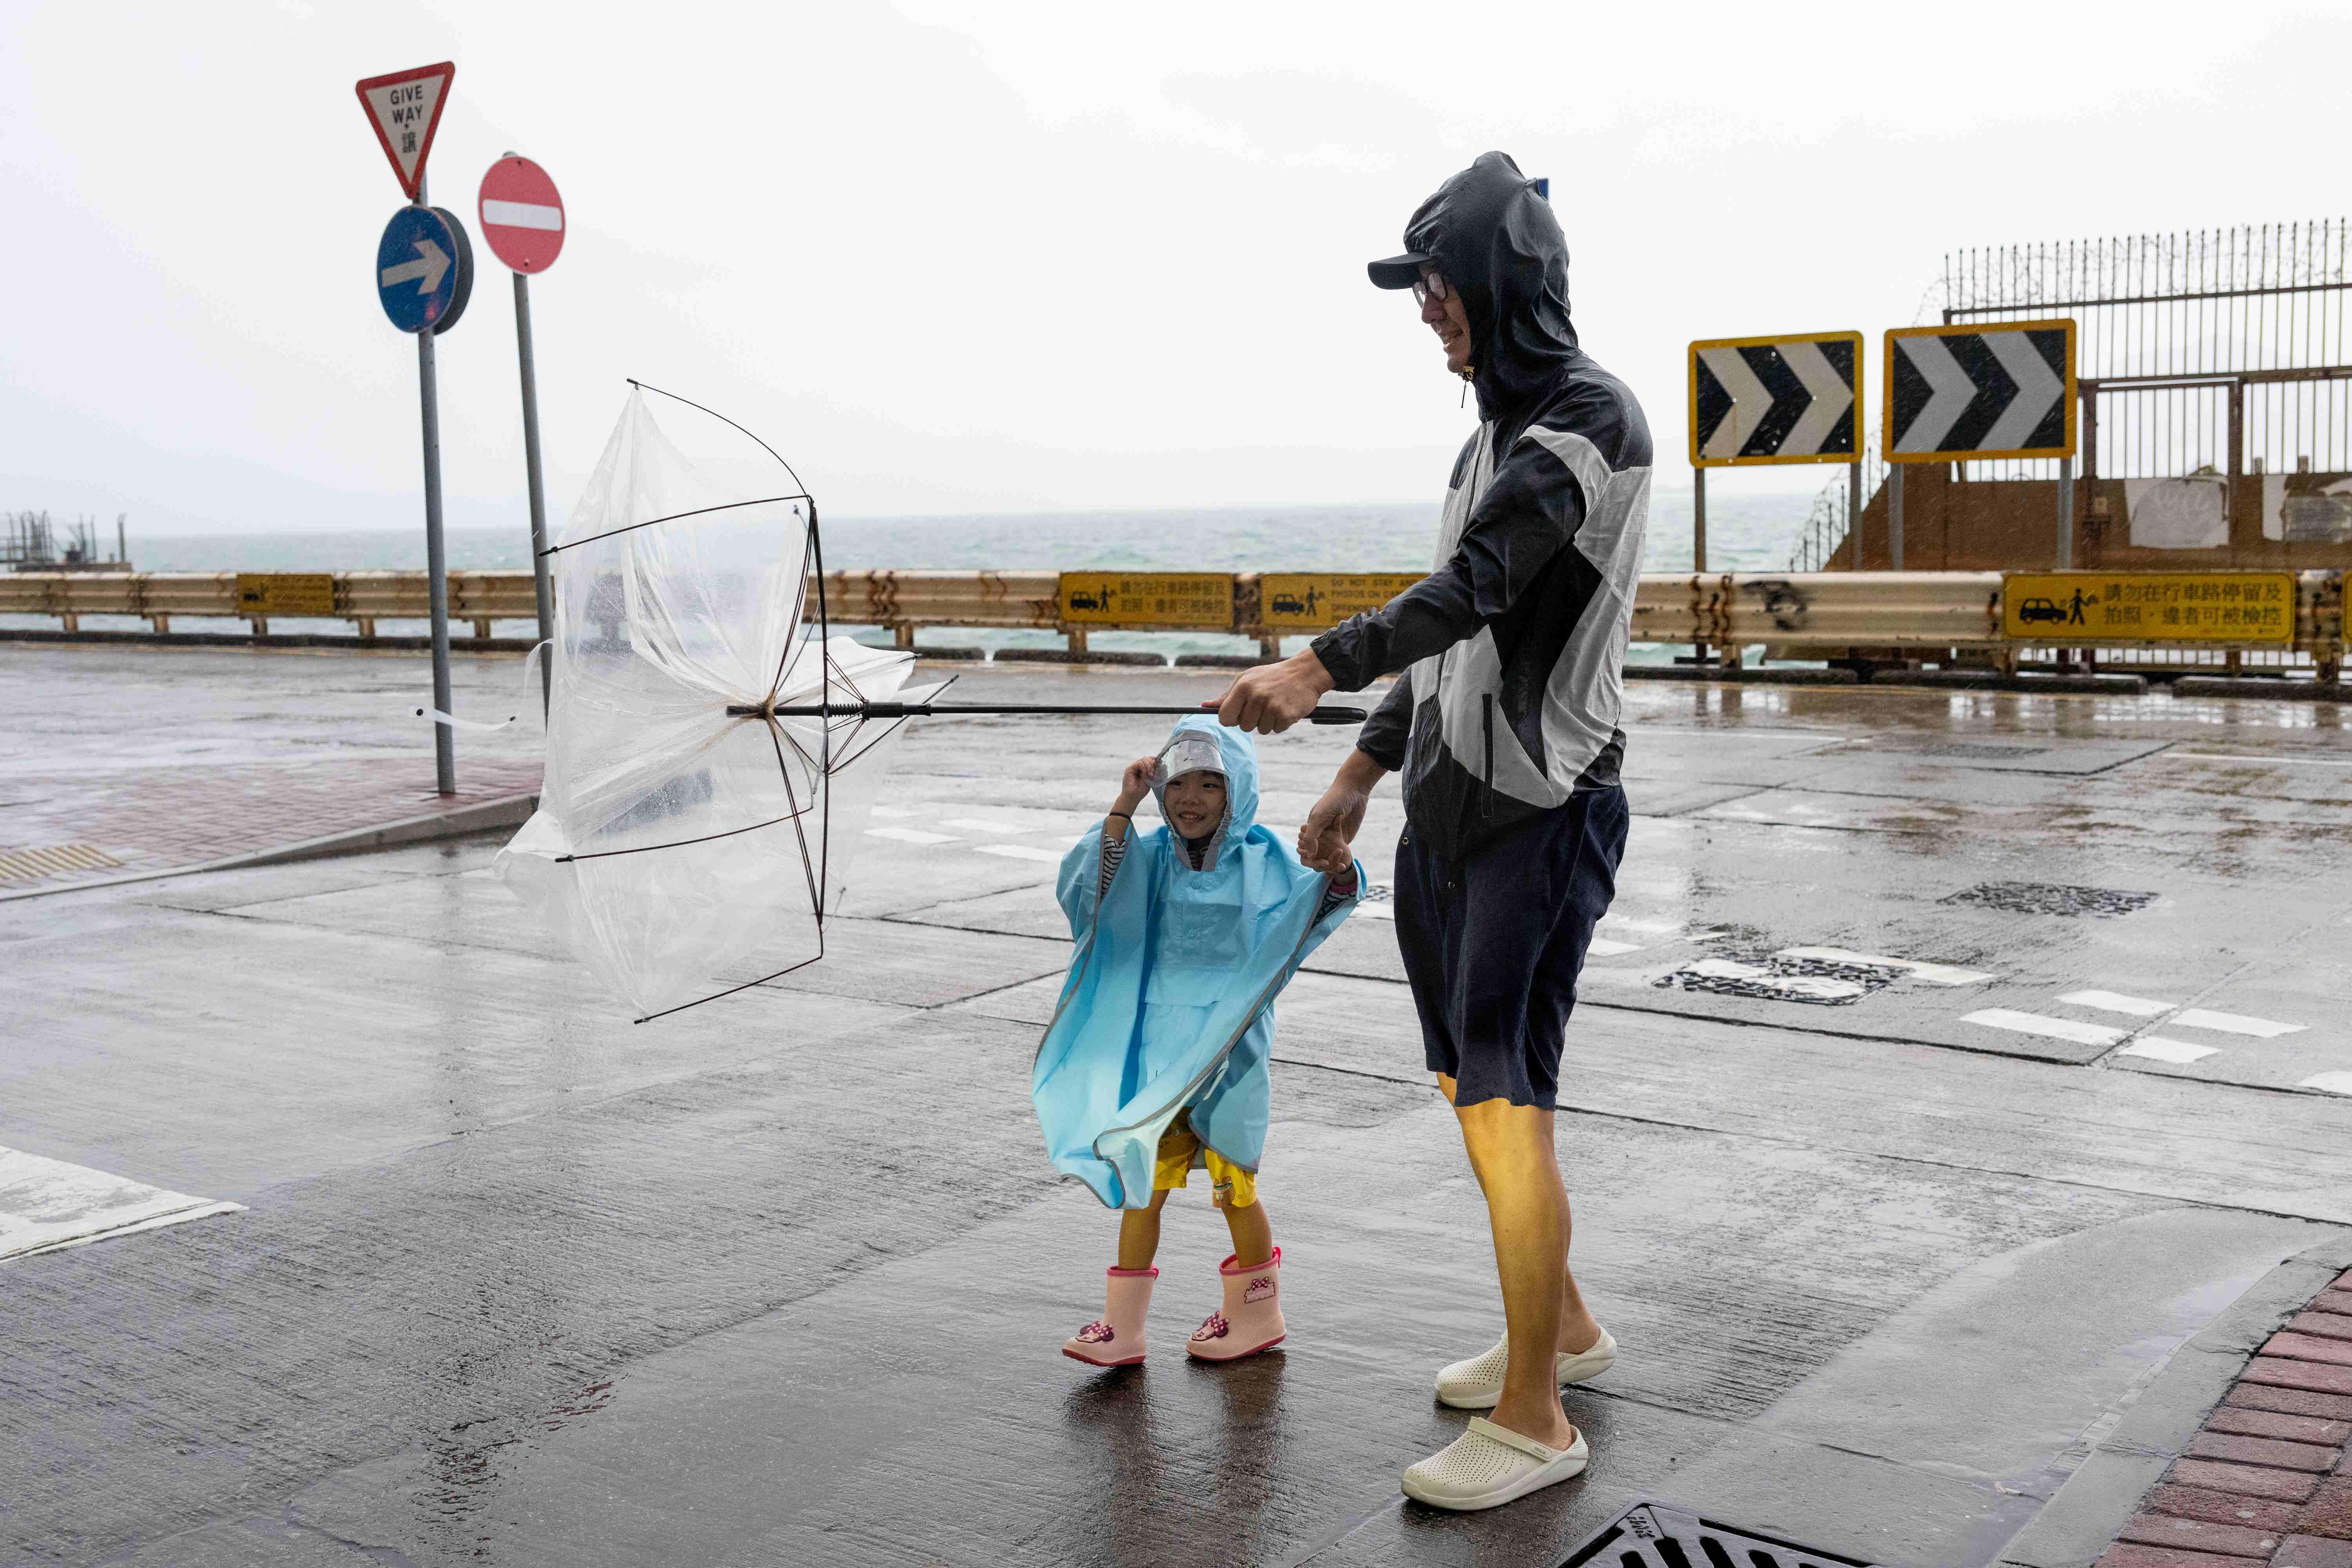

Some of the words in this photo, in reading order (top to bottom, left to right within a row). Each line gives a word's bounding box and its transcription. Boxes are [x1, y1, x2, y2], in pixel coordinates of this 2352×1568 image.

[390, 85, 423, 104] GIVE
[392, 104, 423, 124] WAY
[403, 132, 416, 153] 讓
[2104, 583, 2281, 602] 請勿在行車路停留及
